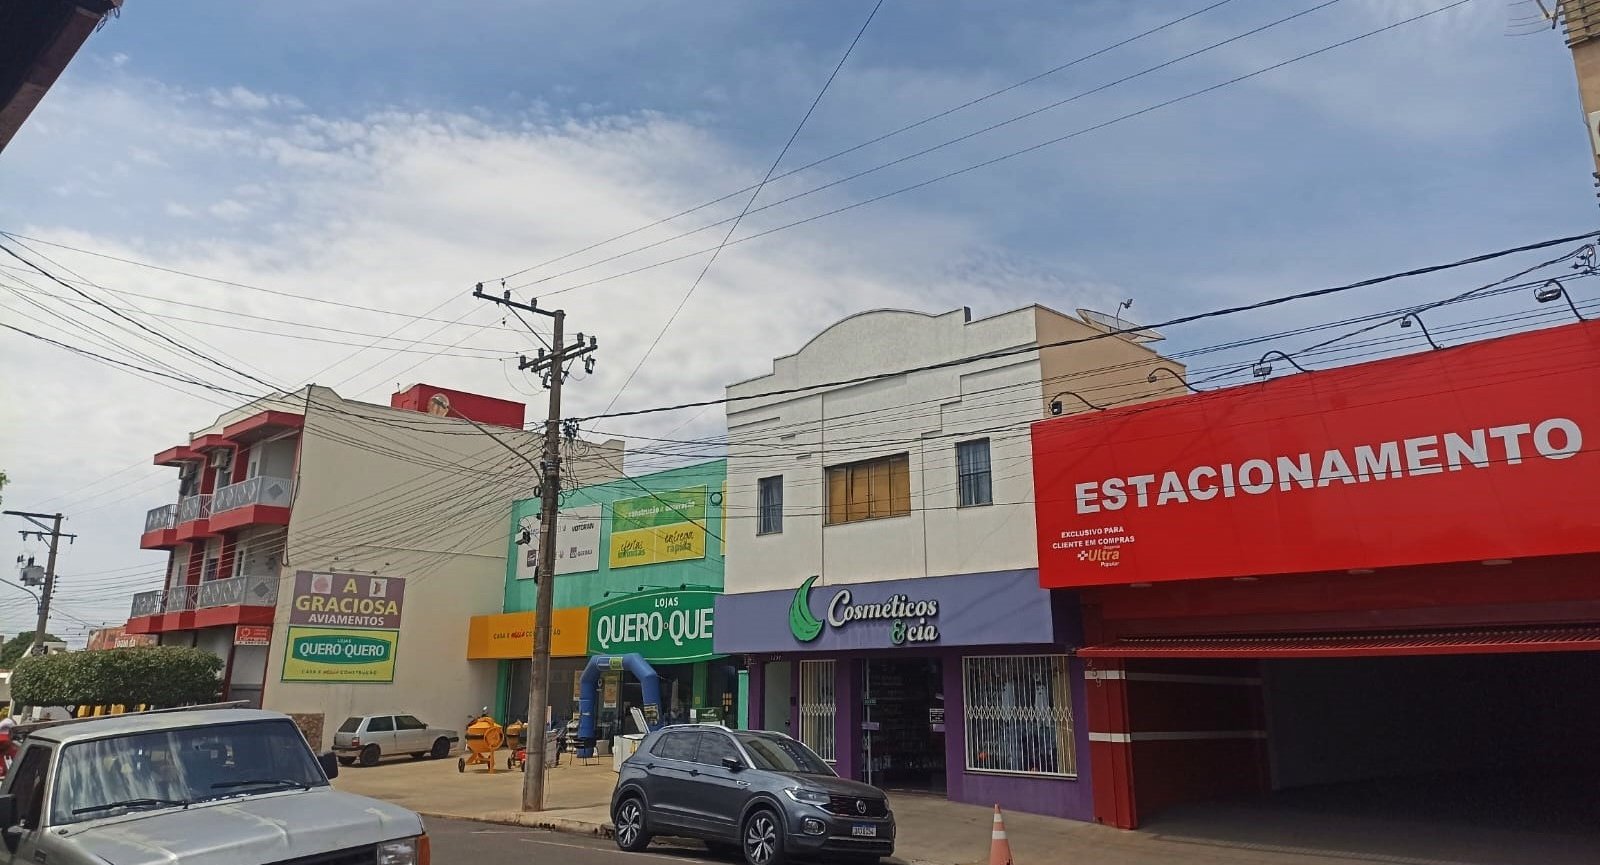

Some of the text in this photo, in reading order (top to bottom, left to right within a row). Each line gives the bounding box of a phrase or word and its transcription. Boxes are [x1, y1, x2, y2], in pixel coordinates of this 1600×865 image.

[1075, 418, 1583, 514] ESTACIONAMENTO
[1061, 526, 1124, 538] EXCLUSIVO PARA
[1052, 540, 1084, 549] CLIENTE
[1098, 536, 1135, 545] COMPRAS
[1088, 549, 1120, 561] Ultra
[343, 578, 358, 594] A
[295, 595, 398, 616] GRACIOSA
[655, 596, 679, 608] LOJAS
[828, 589, 937, 627] Cosméticos
[308, 613, 385, 626] AVIAMENTOS
[597, 607, 714, 649] QUERO QUE
[891, 618, 939, 644] & cia
[300, 642, 385, 658] QUERO QUERO
